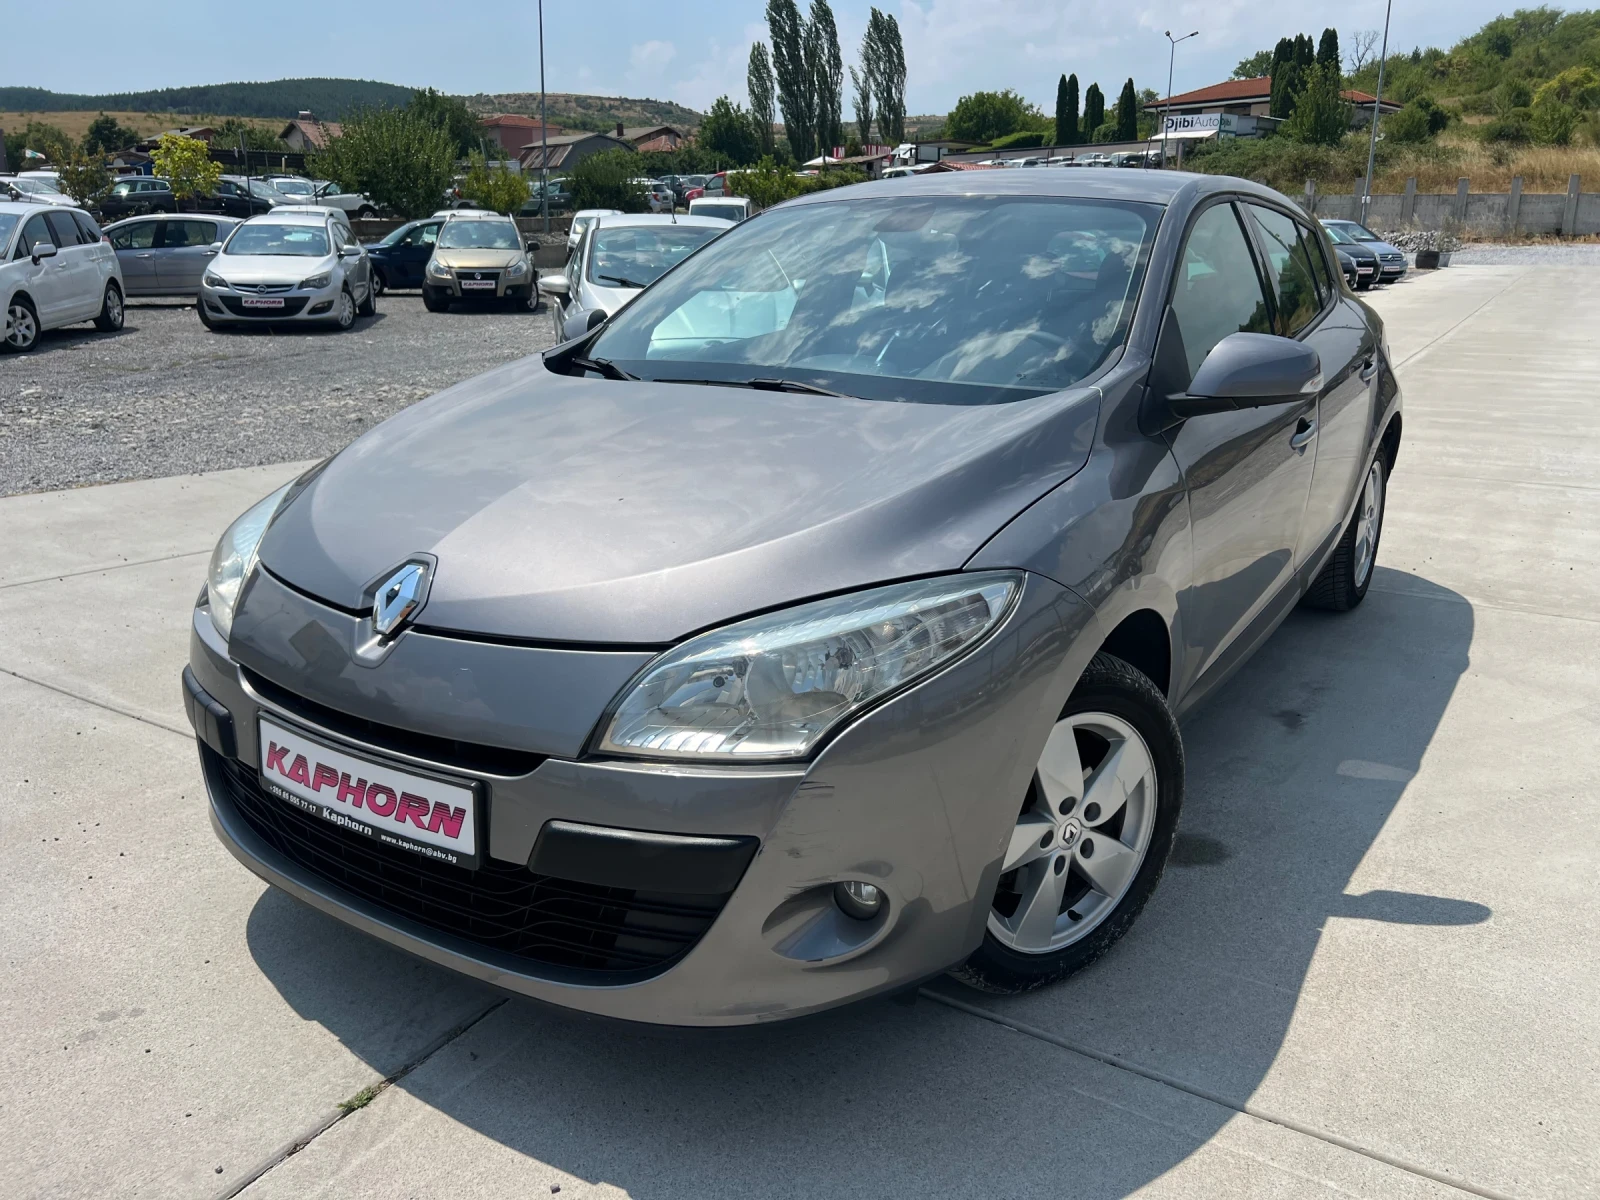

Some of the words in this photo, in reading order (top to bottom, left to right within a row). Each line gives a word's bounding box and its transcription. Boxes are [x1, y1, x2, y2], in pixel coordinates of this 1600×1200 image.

[266, 740, 467, 840] KAPHORN
[300, 800, 308, 809] 77
[308, 804, 317, 813] 17
[322, 807, 373, 836] Kaphorn
[380, 834, 458, 864] www.kaphorn@abv.bg
